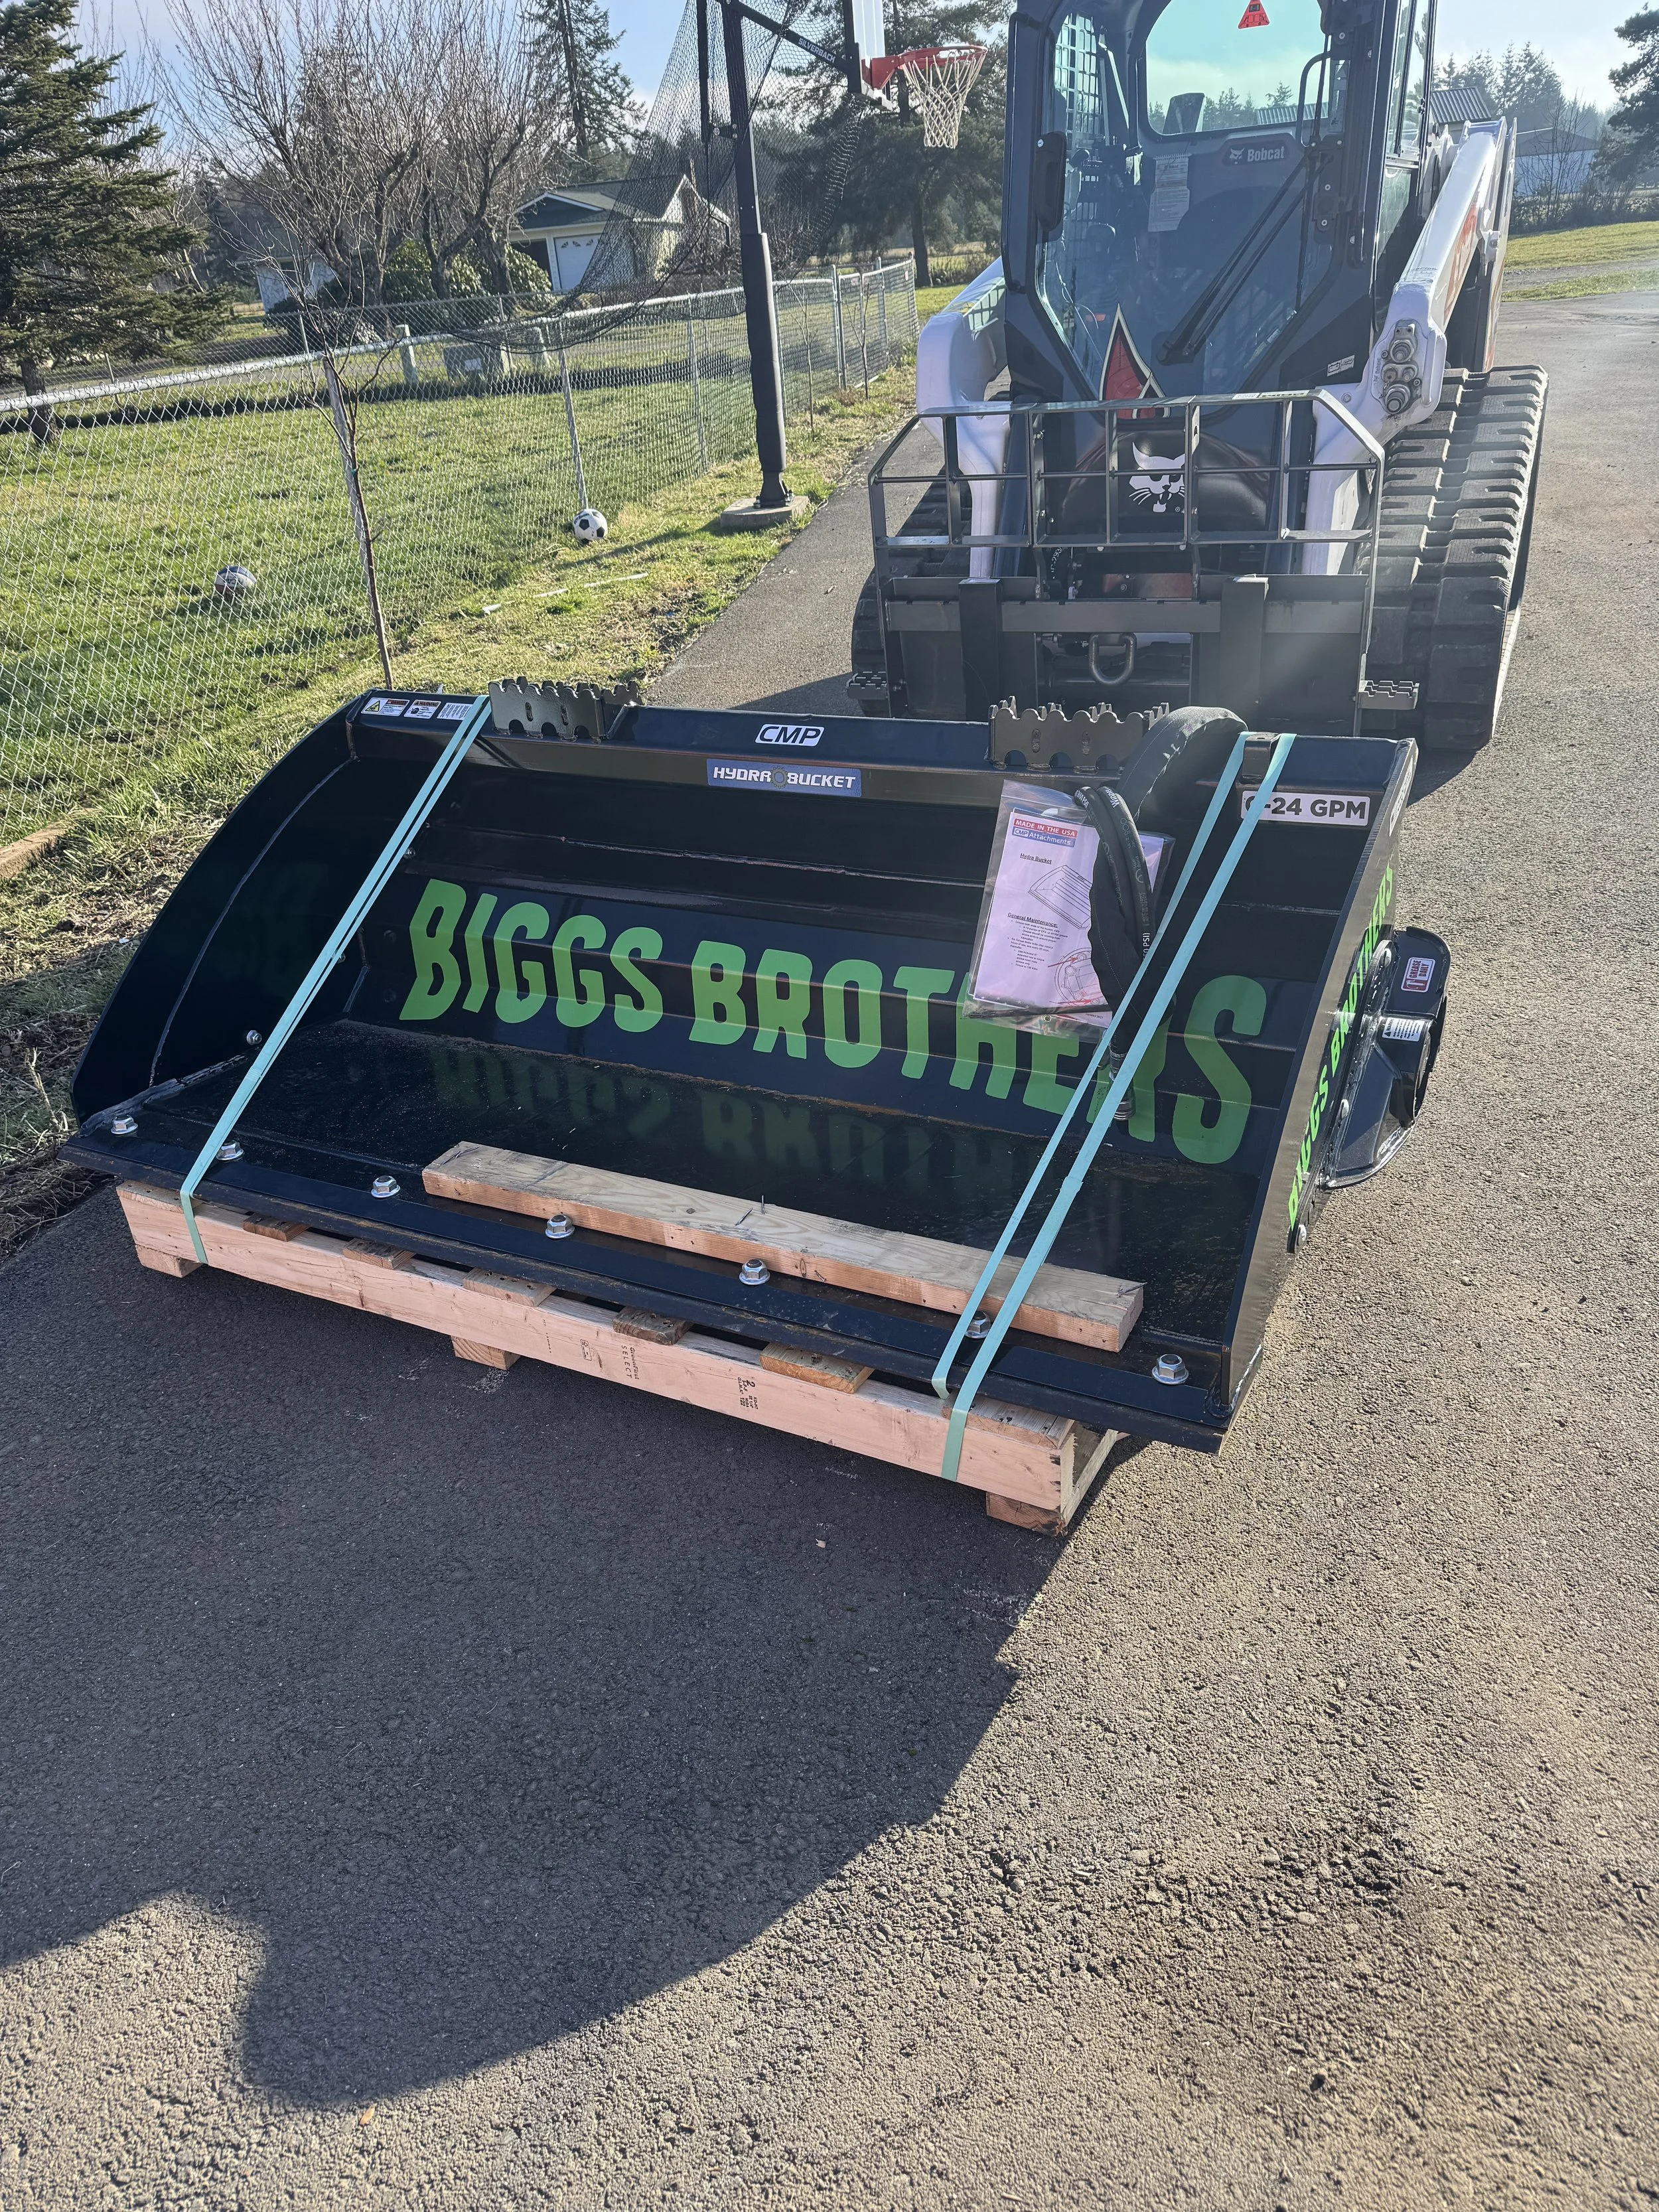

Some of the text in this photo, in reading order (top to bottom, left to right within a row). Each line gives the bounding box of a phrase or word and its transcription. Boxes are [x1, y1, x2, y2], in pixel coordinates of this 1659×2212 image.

[798, 37, 836, 63] SILVERBACK
[1247, 146, 1285, 162] Bobcat
[759, 726, 821, 745] CMP
[713, 767, 856, 789] HYDRA BUCKET
[1310, 798, 1366, 820] GPM
[1015, 820, 1035, 829] MADE
[1029, 832, 1072, 846] Attachments
[1007, 912, 1026, 921] General
[399, 877, 664, 1033] BIGGS
[1409, 960, 1421, 978] GREASE
[1418, 962, 1429, 978] DAILY
[621, 1345, 632, 1378] SELECT
